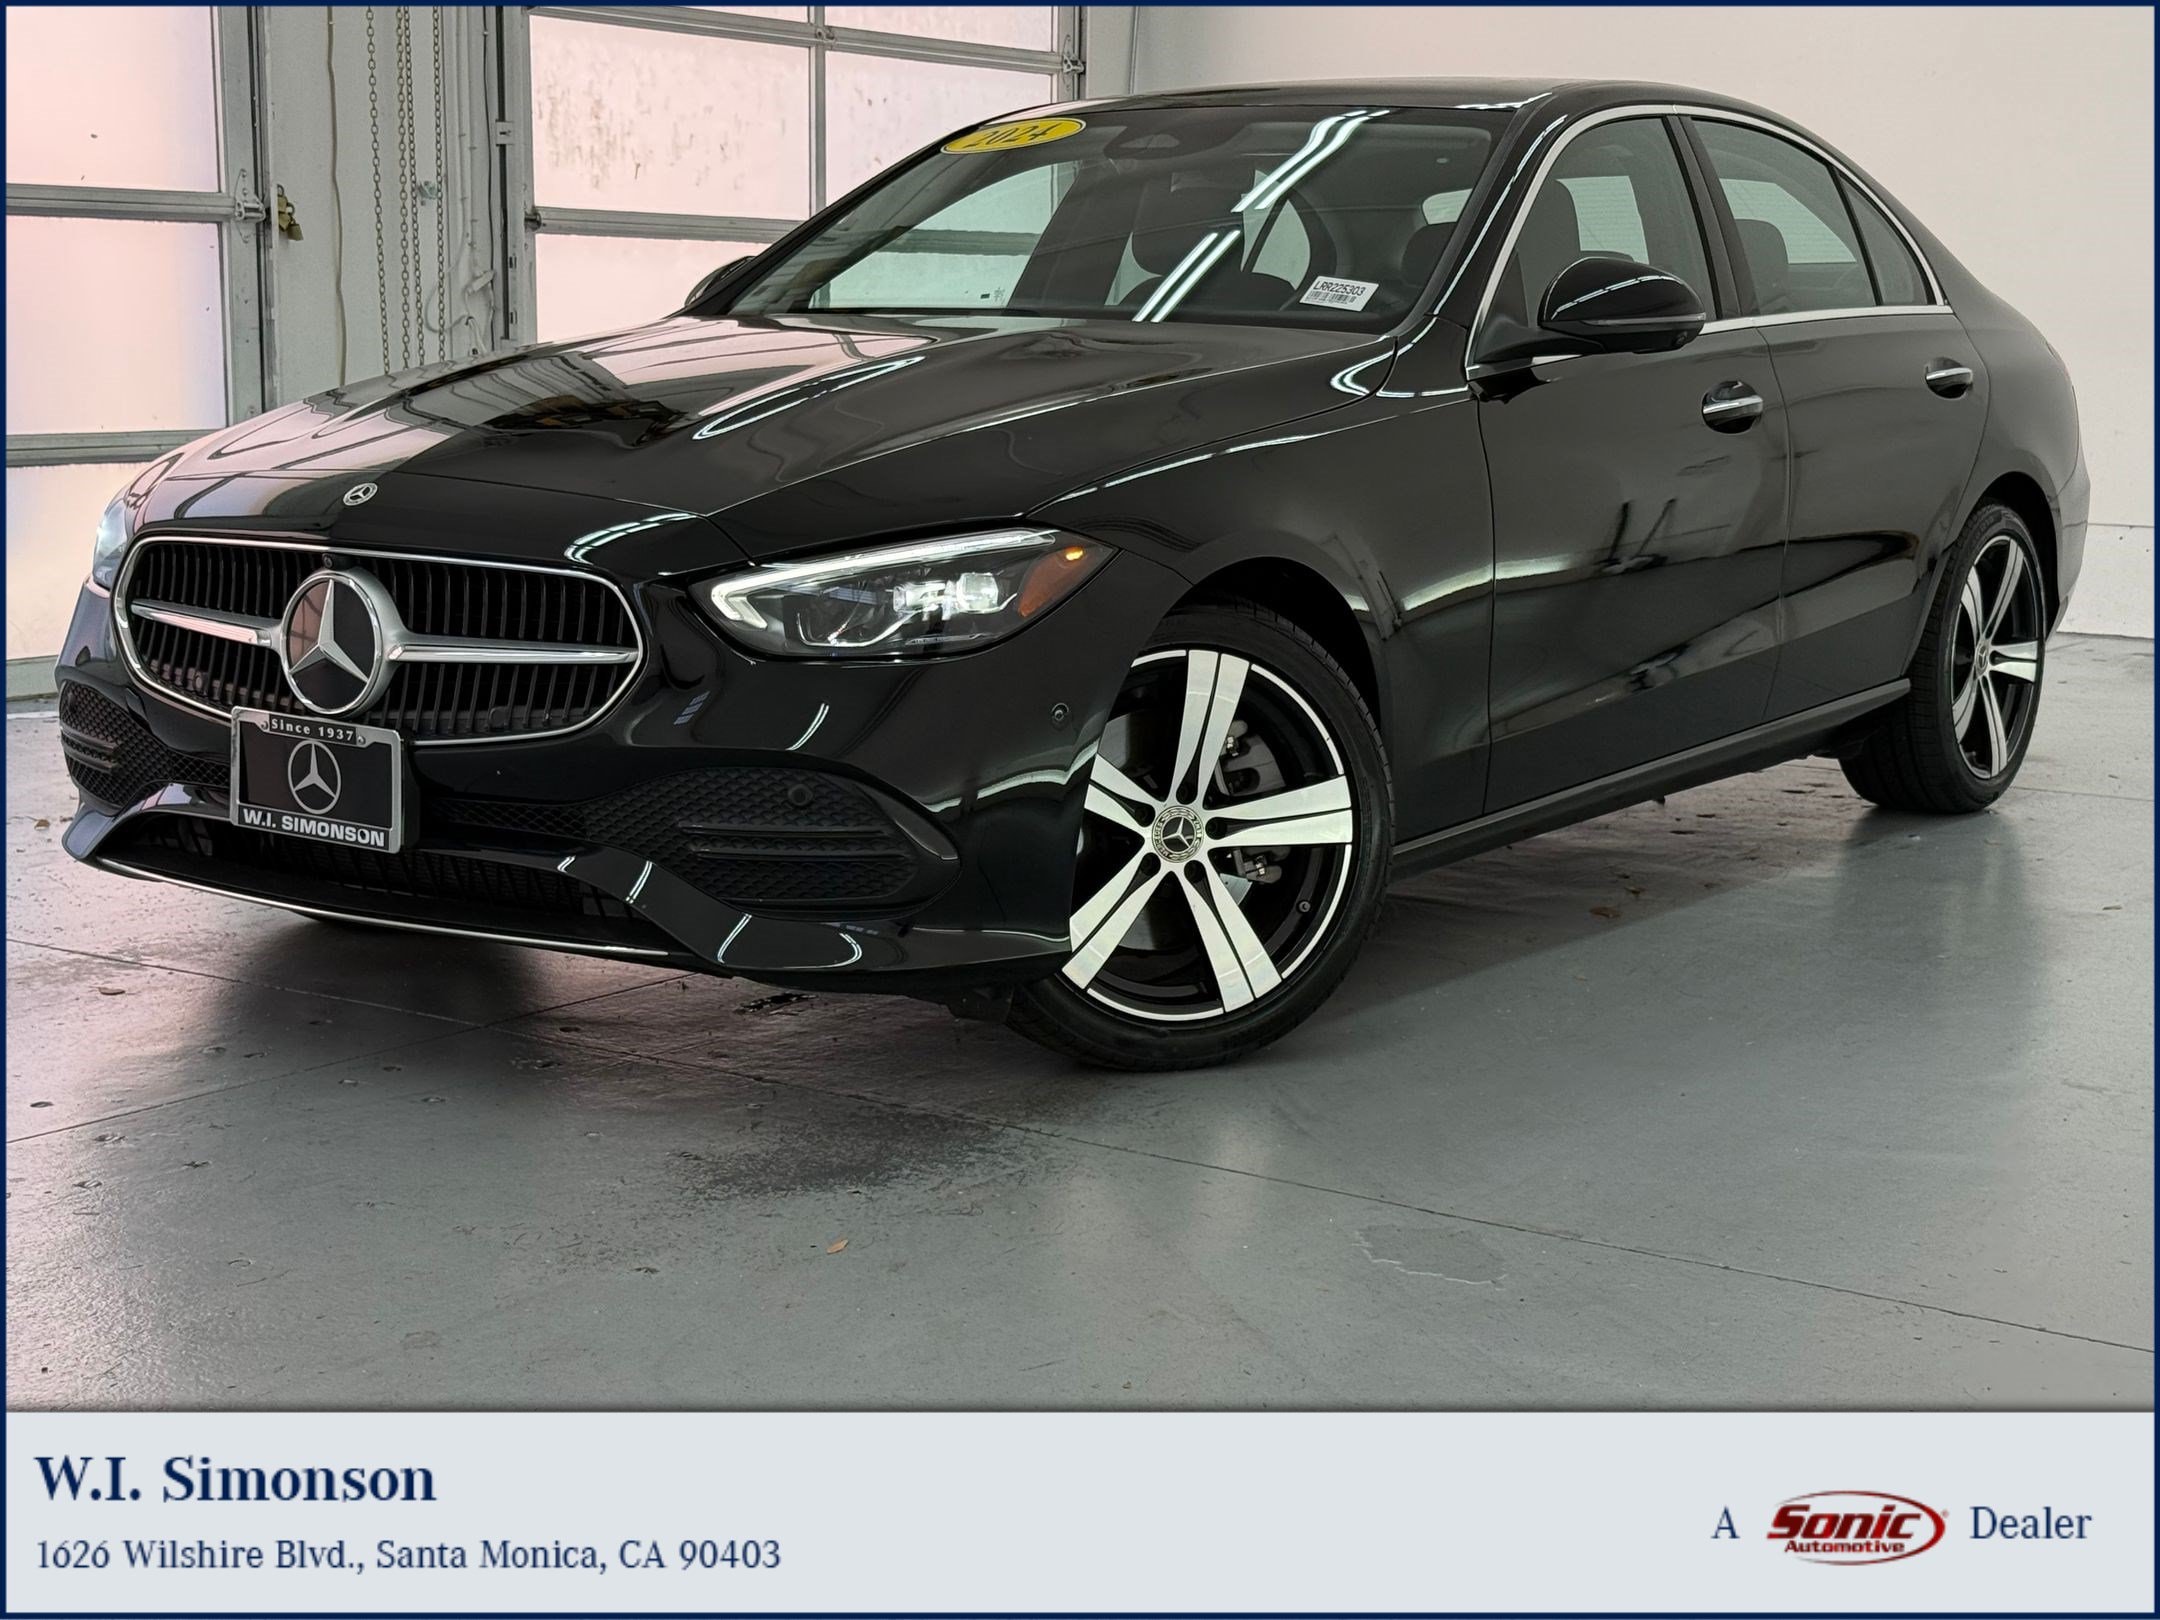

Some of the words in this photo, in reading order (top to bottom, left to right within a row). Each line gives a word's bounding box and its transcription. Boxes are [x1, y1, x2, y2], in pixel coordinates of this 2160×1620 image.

[962, 123, 1062, 149] 2024
[271, 718, 311, 735] Since
[318, 726, 354, 741] 1937
[243, 808, 277, 829] W.I.
[281, 815, 385, 847] SIMONSON
